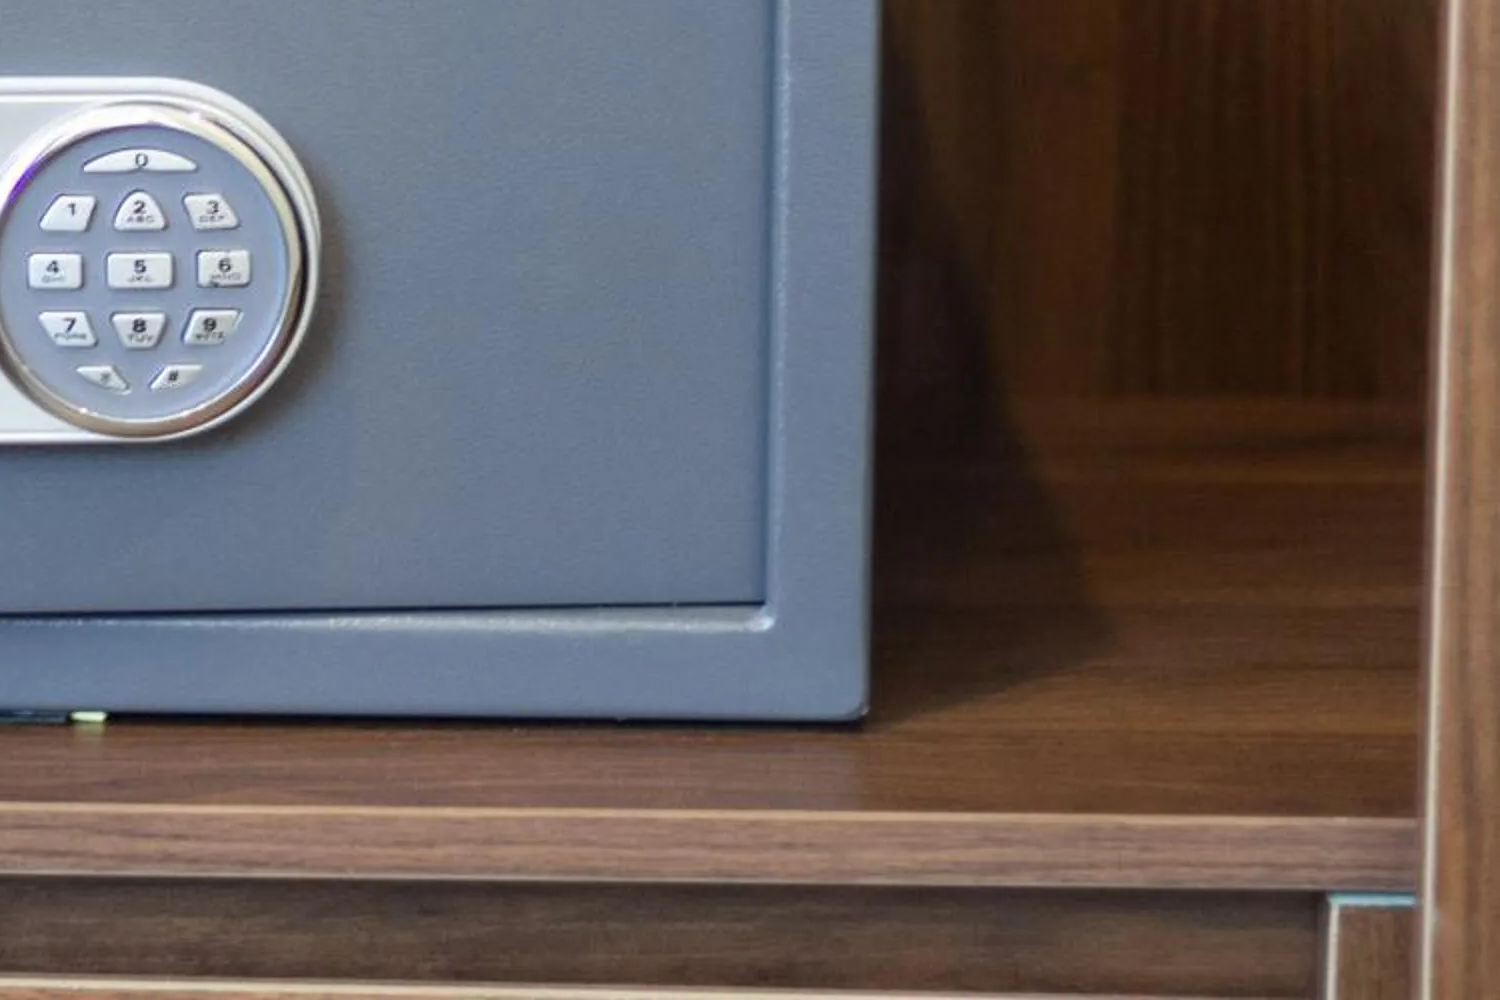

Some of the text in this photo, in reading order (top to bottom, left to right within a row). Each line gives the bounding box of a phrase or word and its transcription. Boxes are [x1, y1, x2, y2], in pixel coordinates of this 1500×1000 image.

[134, 153, 148, 169] 0
[67, 200, 220, 217] 1 2 3
[46, 258, 232, 274] 4 5 6
[63, 317, 217, 333] 7 8 9
